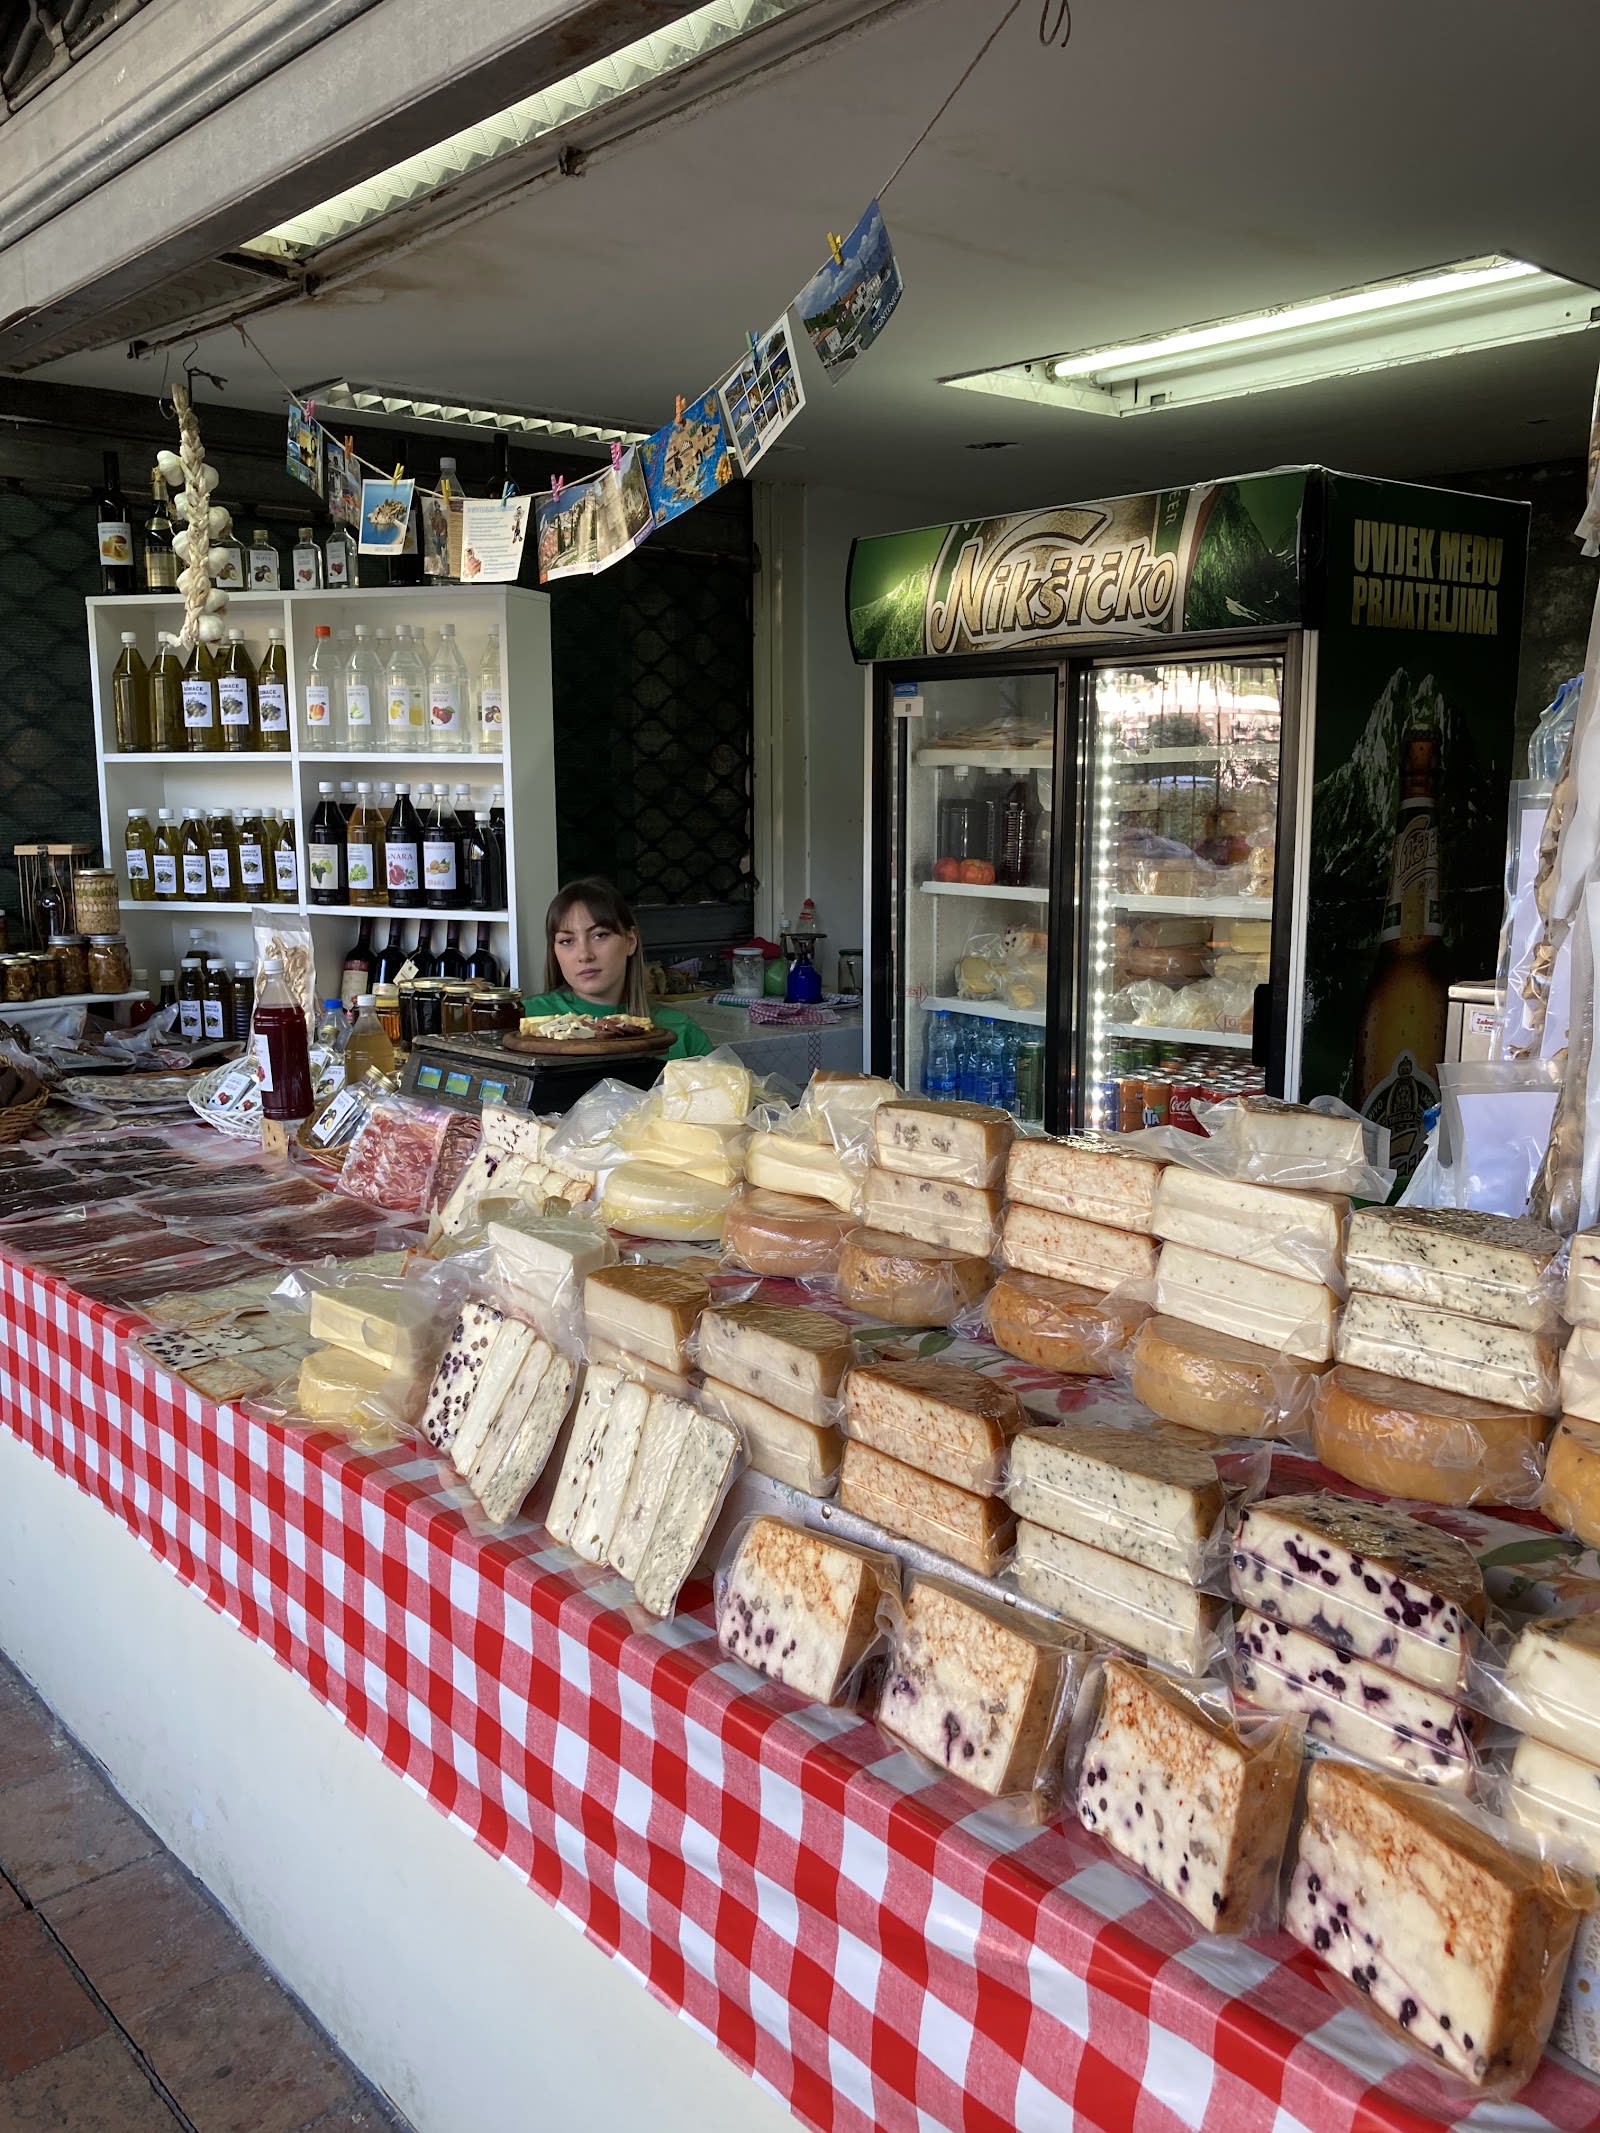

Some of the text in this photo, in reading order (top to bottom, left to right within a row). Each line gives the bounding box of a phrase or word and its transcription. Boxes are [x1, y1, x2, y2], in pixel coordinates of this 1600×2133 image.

[1165, 490, 1182, 527] EER
[1353, 518, 1436, 580] UVIJEK
[1350, 574, 1500, 637] PRIJATELJIMA
